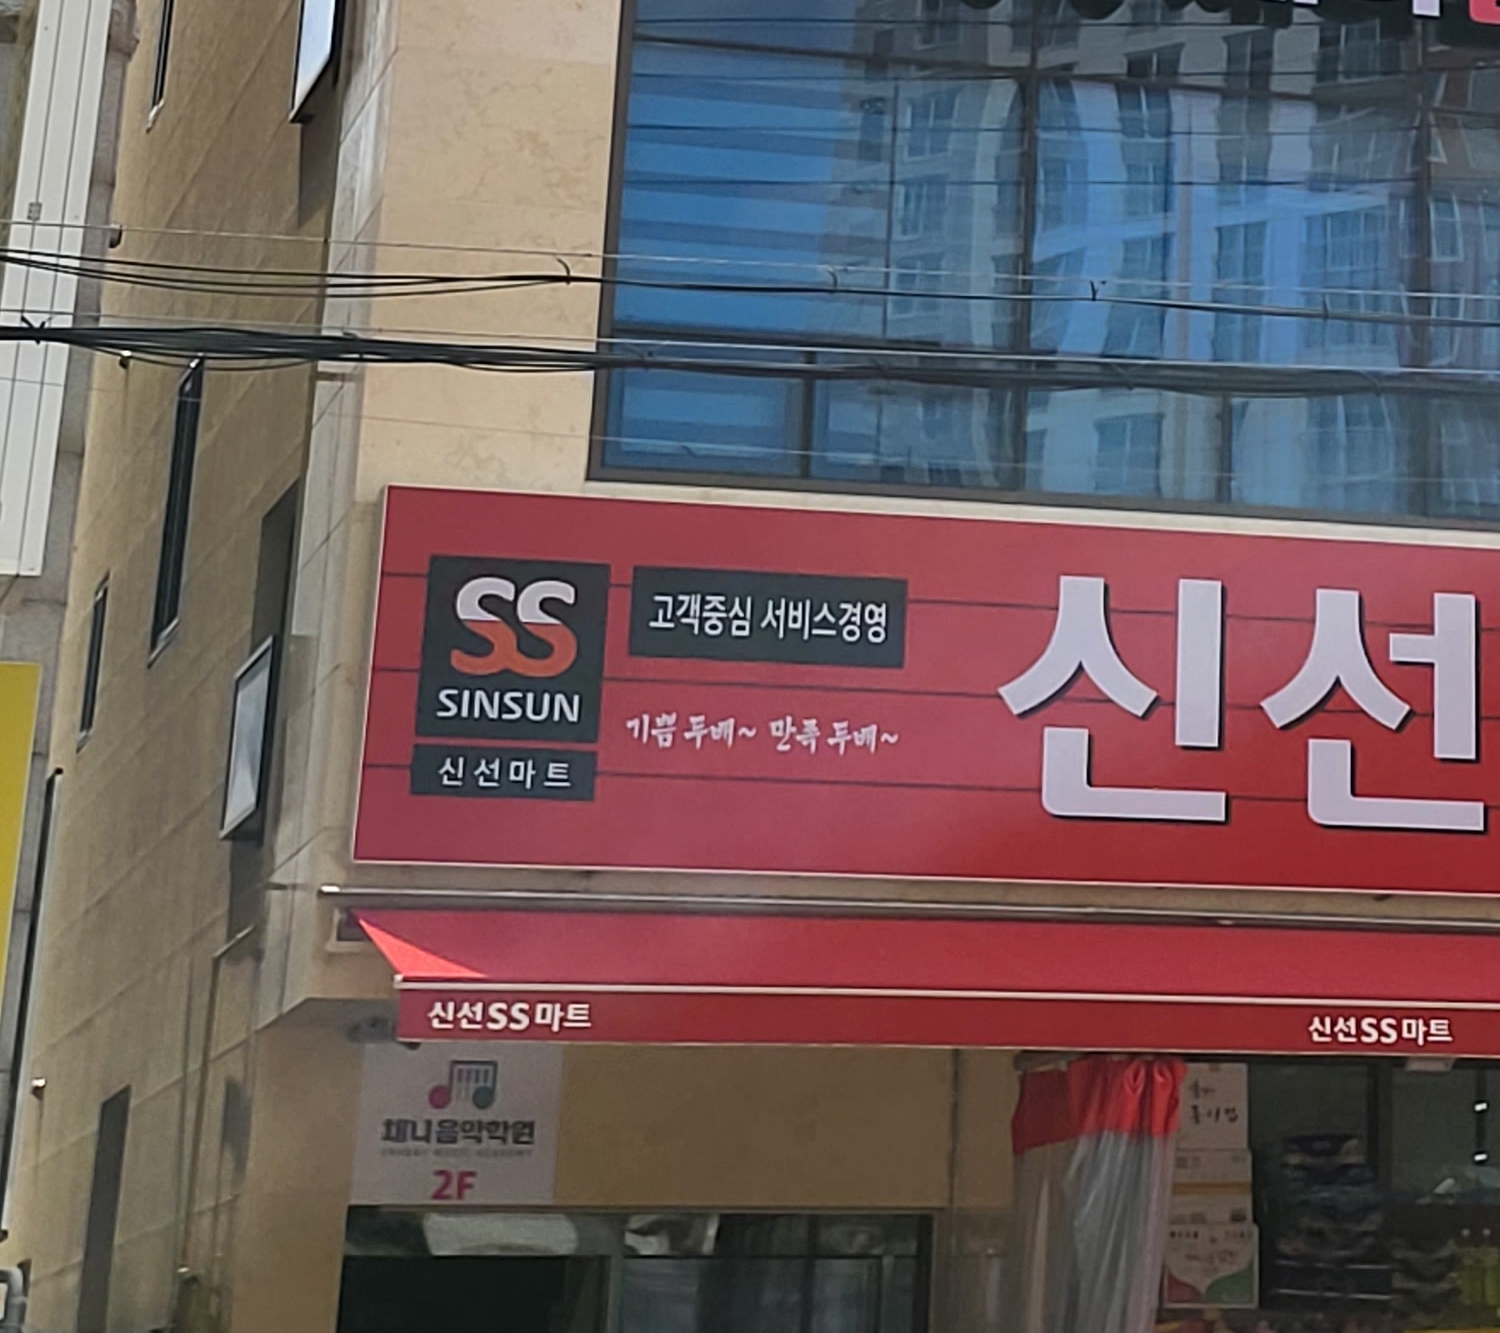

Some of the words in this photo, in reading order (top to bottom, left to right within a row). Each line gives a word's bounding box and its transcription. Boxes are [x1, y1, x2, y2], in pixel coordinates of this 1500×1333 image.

[649, 593, 752, 637] 고객중심
[760, 598, 887, 644] 서비스경영
[436, 688, 581, 723] SINSUN
[626, 712, 677, 749] 기쁨
[770, 716, 821, 753] 만족
[427, 1000, 592, 1031] 신선SS마트
[1308, 1015, 1453, 1045] 신선SS마트
[431, 1169, 477, 1200] 2F
